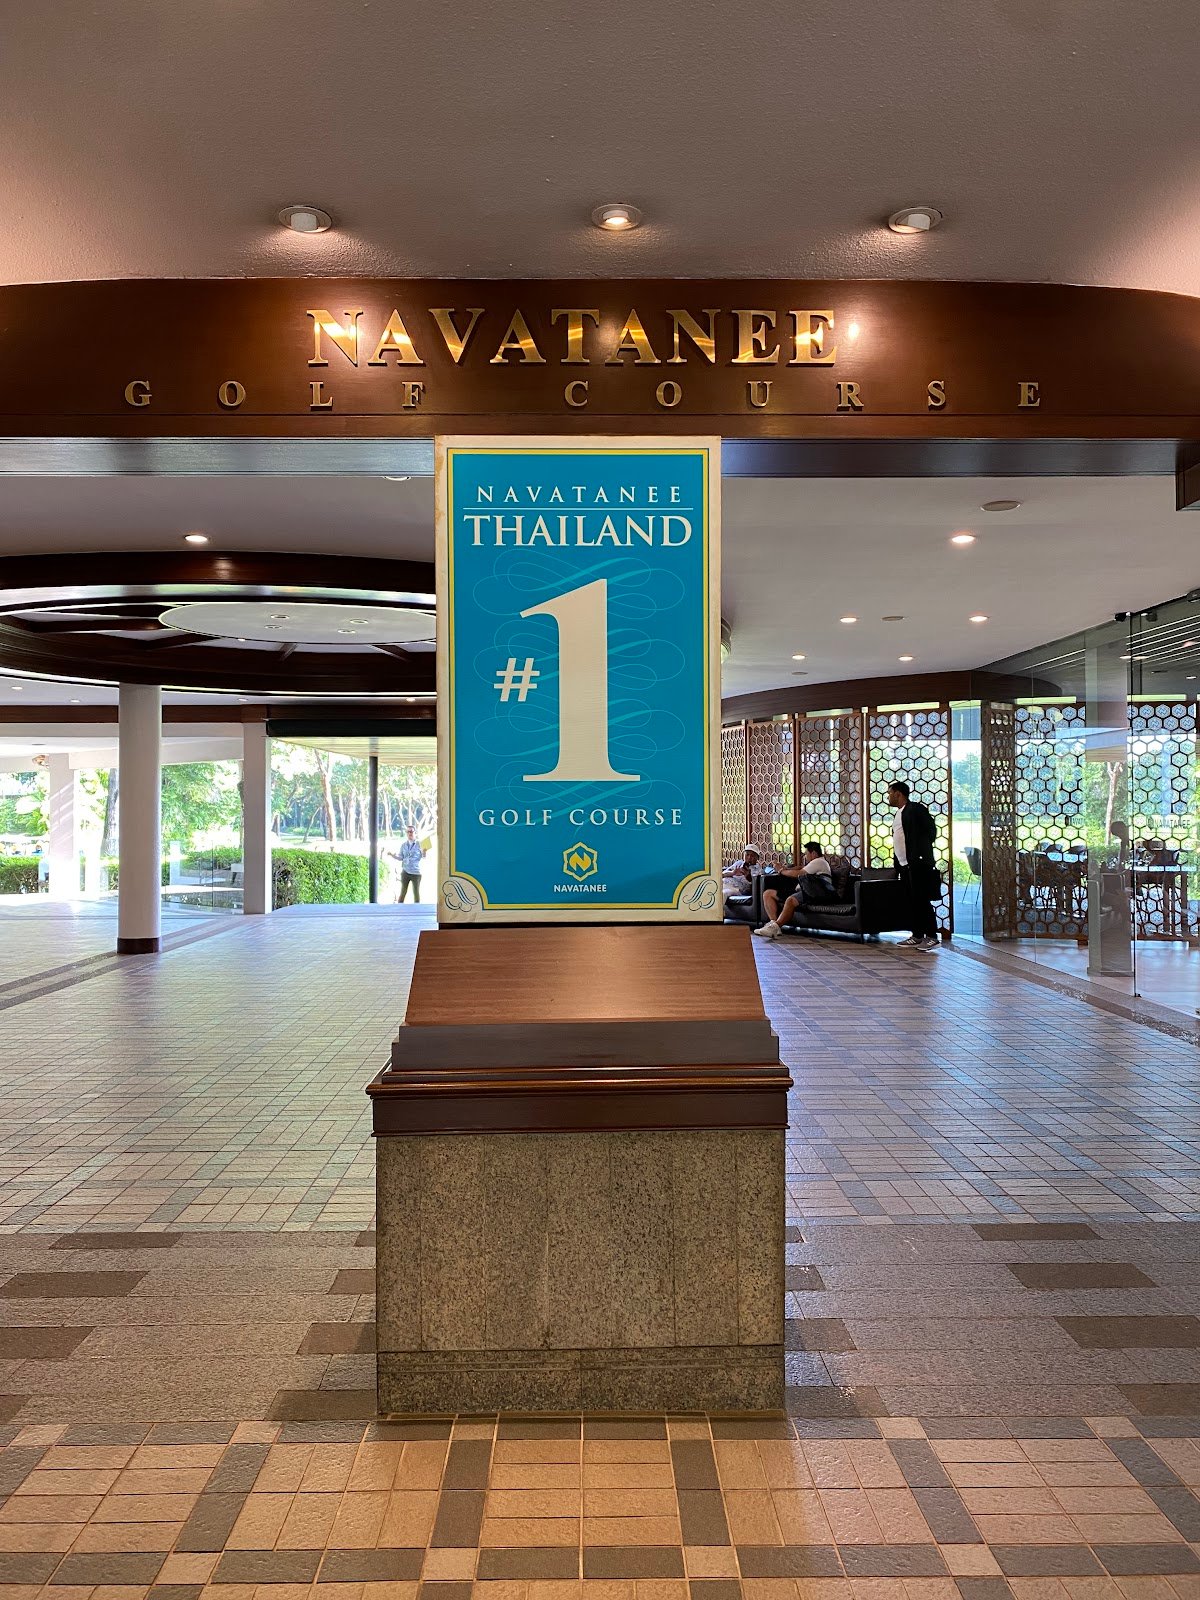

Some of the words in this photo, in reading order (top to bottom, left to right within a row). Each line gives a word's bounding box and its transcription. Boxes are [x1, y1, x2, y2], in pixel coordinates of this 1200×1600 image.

[306, 308, 837, 366] NAVATANEE
[124, 380, 426, 408] GOLF
[564, 380, 1041, 411] COURSE
[477, 486, 681, 503] NAVATANEE
[463, 514, 692, 547] THAILAND
[478, 808, 552, 826] GOLF
[569, 808, 682, 826] COURSE
[553, 884, 607, 893] NAVATANEE
